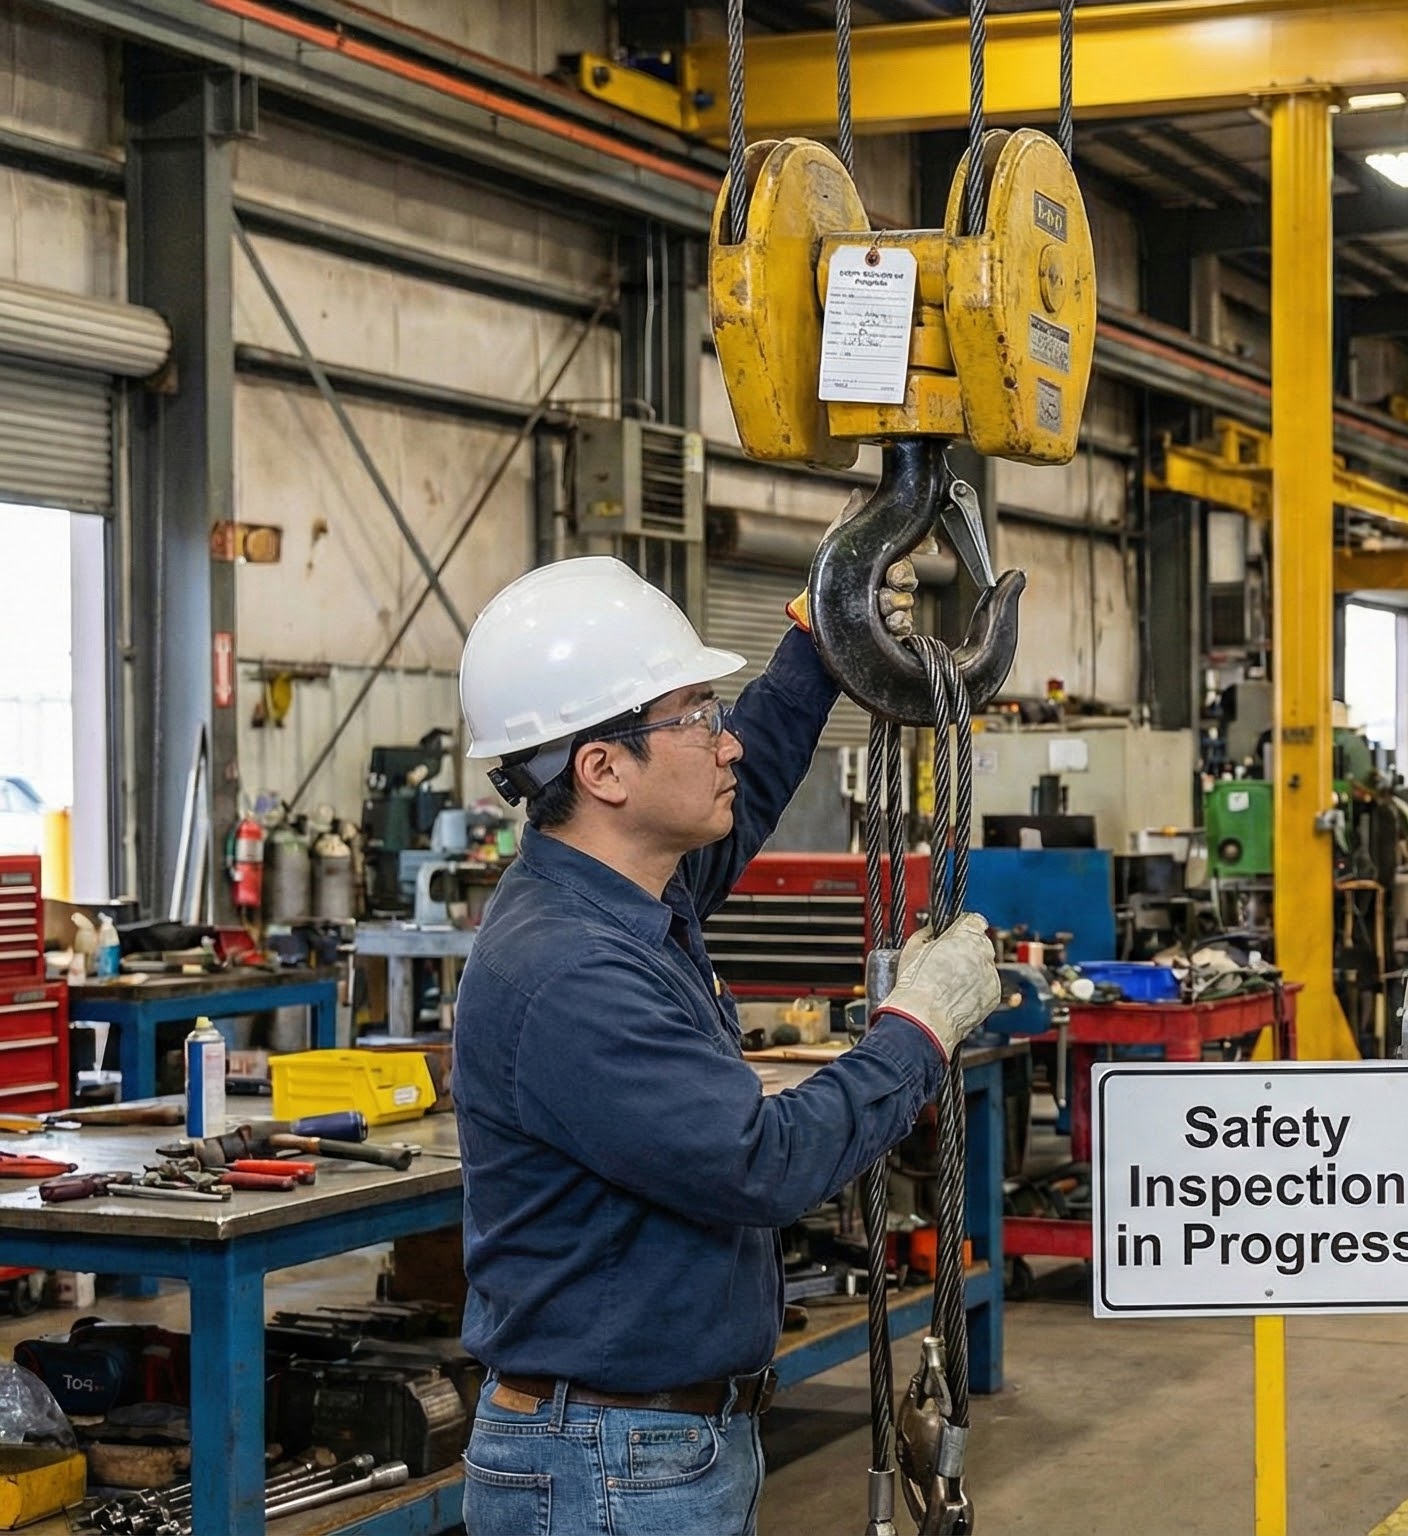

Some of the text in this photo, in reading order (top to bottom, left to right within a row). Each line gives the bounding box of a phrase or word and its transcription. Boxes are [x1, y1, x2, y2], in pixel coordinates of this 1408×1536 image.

[1184, 1105, 1351, 1158] Safety
[1130, 1163, 1405, 1216] Inspection
[1117, 1224, 1162, 1266] in
